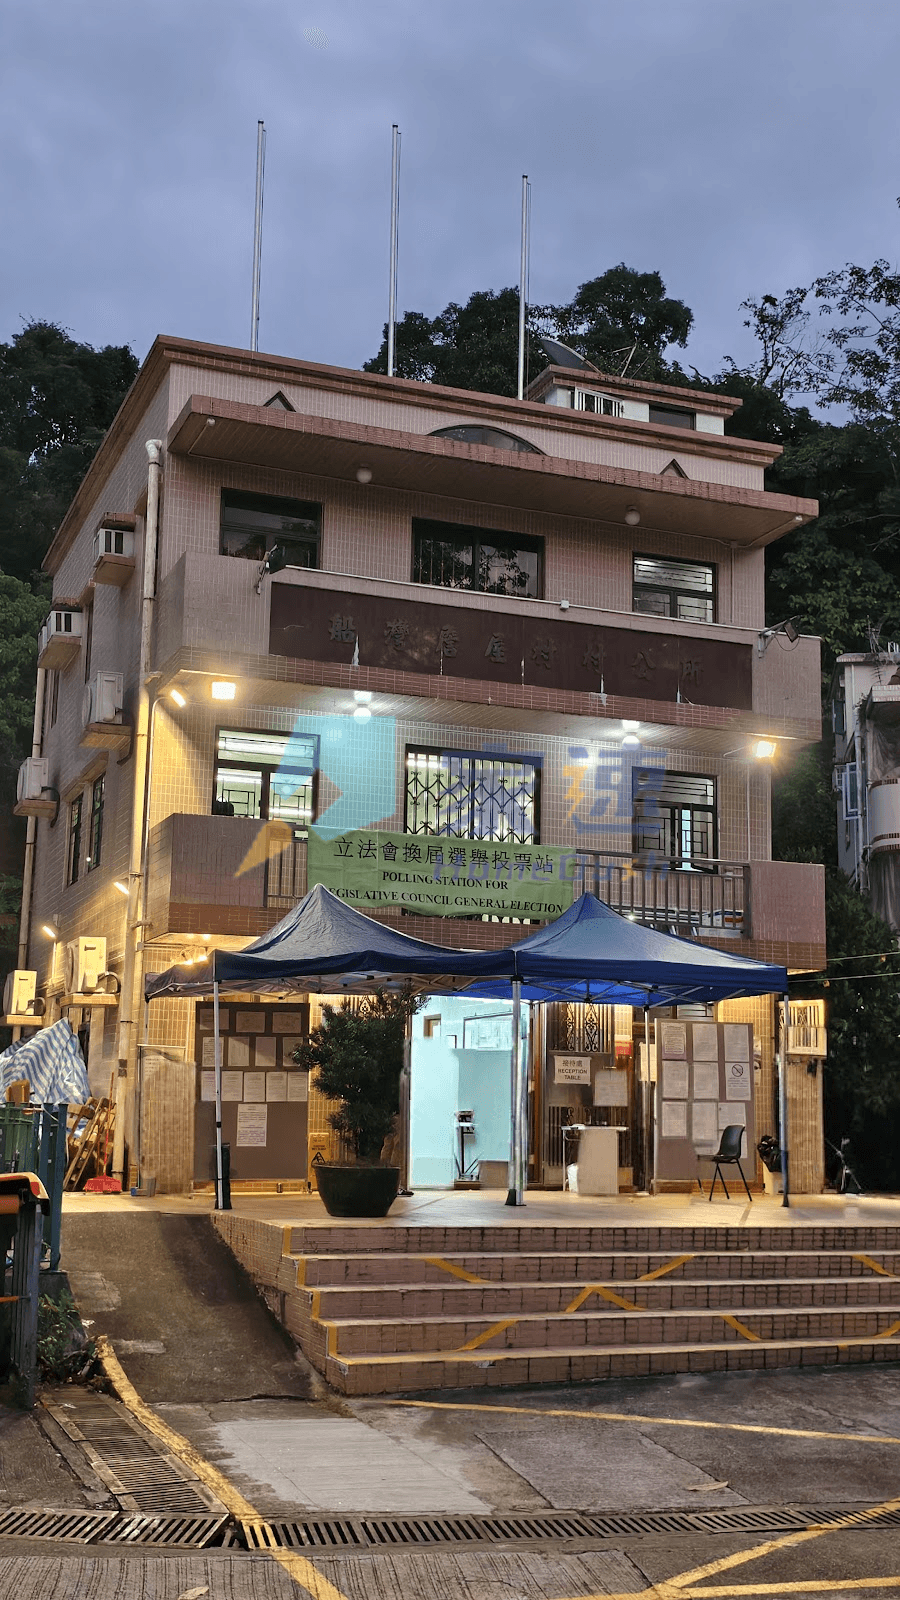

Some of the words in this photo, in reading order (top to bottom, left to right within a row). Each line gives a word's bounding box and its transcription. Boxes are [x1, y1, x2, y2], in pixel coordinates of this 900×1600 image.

[333, 837, 554, 874] 立法會換屆選舉投票站
[382, 871, 434, 885] POLLING
[435, 876, 484, 889] STATION
[485, 879, 509, 890] FOR
[328, 887, 399, 901] EGISLATIVE
[401, 892, 453, 906] COUNCIL
[454, 896, 509, 909] GENERAL
[510, 900, 564, 914] ELECTION
